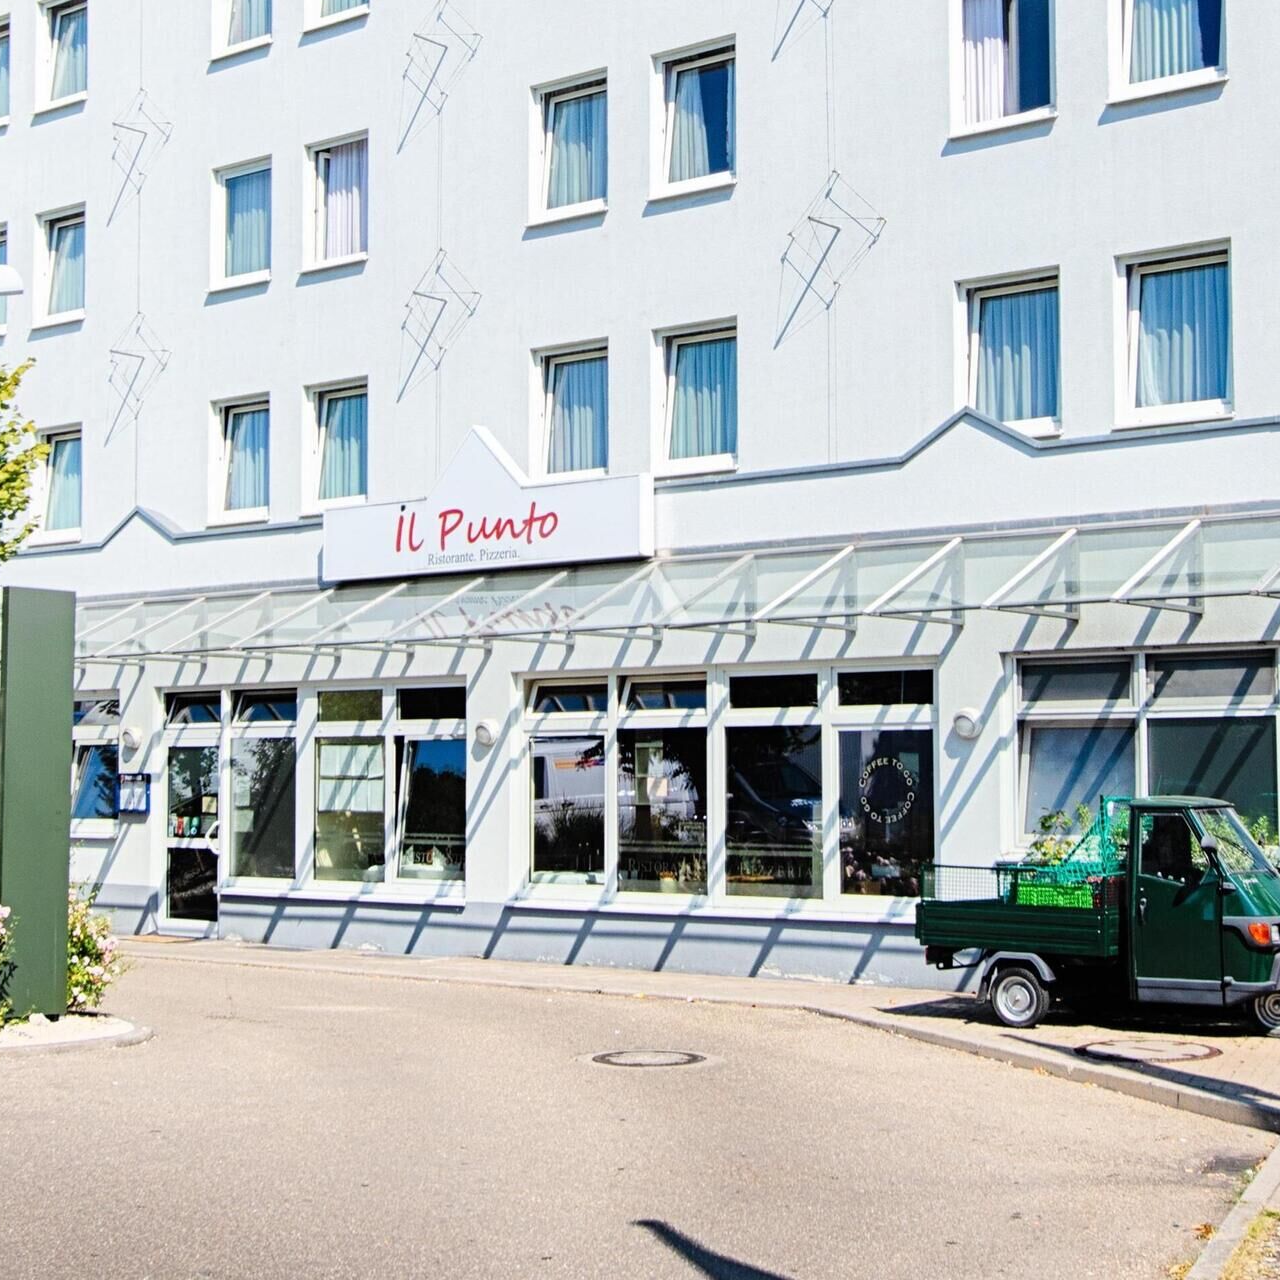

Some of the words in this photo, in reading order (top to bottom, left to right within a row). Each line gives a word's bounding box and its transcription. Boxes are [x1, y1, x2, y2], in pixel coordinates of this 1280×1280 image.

[438, 501, 559, 551] Punto
[859, 757, 889, 788] COFFEE
[891, 758, 904, 770] TO
[903, 770, 913, 786] GO
[860, 796, 871, 812] GO
[870, 812, 882, 823] TO
[885, 792, 915, 823] COFFEE
